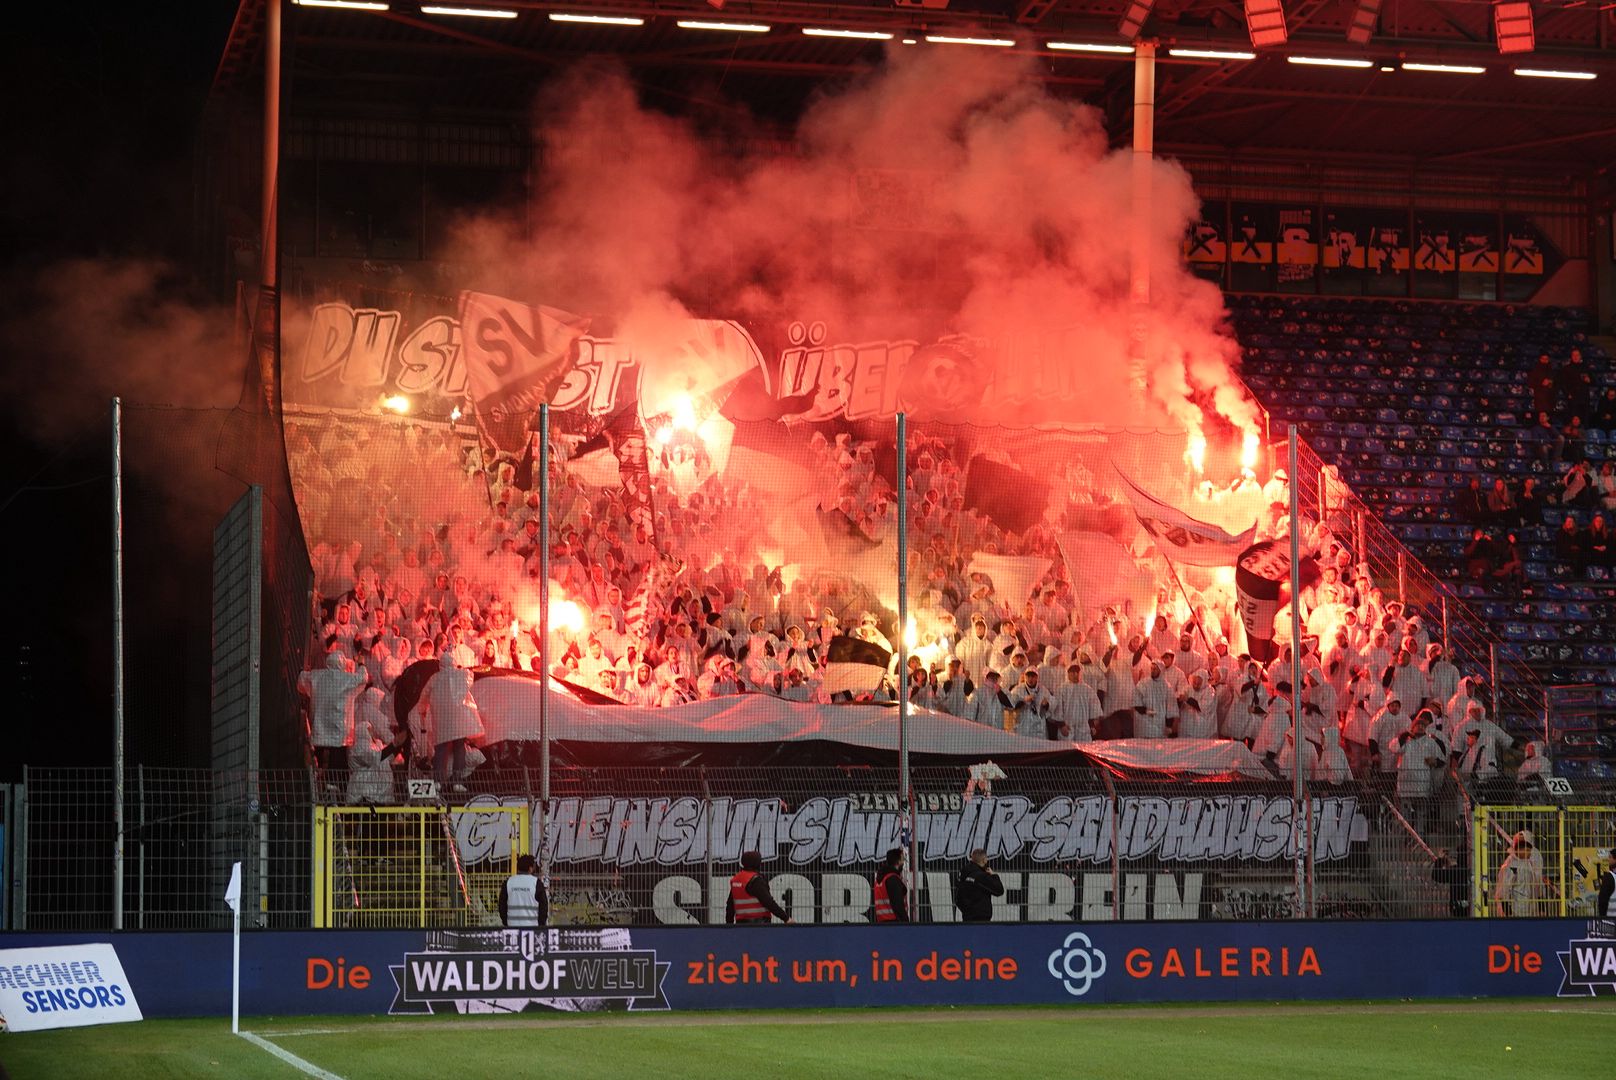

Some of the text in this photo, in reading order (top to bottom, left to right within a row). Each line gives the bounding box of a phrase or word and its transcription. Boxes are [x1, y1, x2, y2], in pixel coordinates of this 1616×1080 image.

[412, 782, 432, 795] 27
[1549, 781, 1569, 792] 26
[918, 793, 960, 811] 1916
[306, 950, 1018, 990] Die zieht um, in deine
[1124, 947, 1322, 979] GALERIA
[1487, 943, 1543, 974] Die
[0, 960, 105, 989] RECHNER
[411, 958, 649, 992] WALDHOF WELT
[22, 984, 126, 1014] SENSORS
